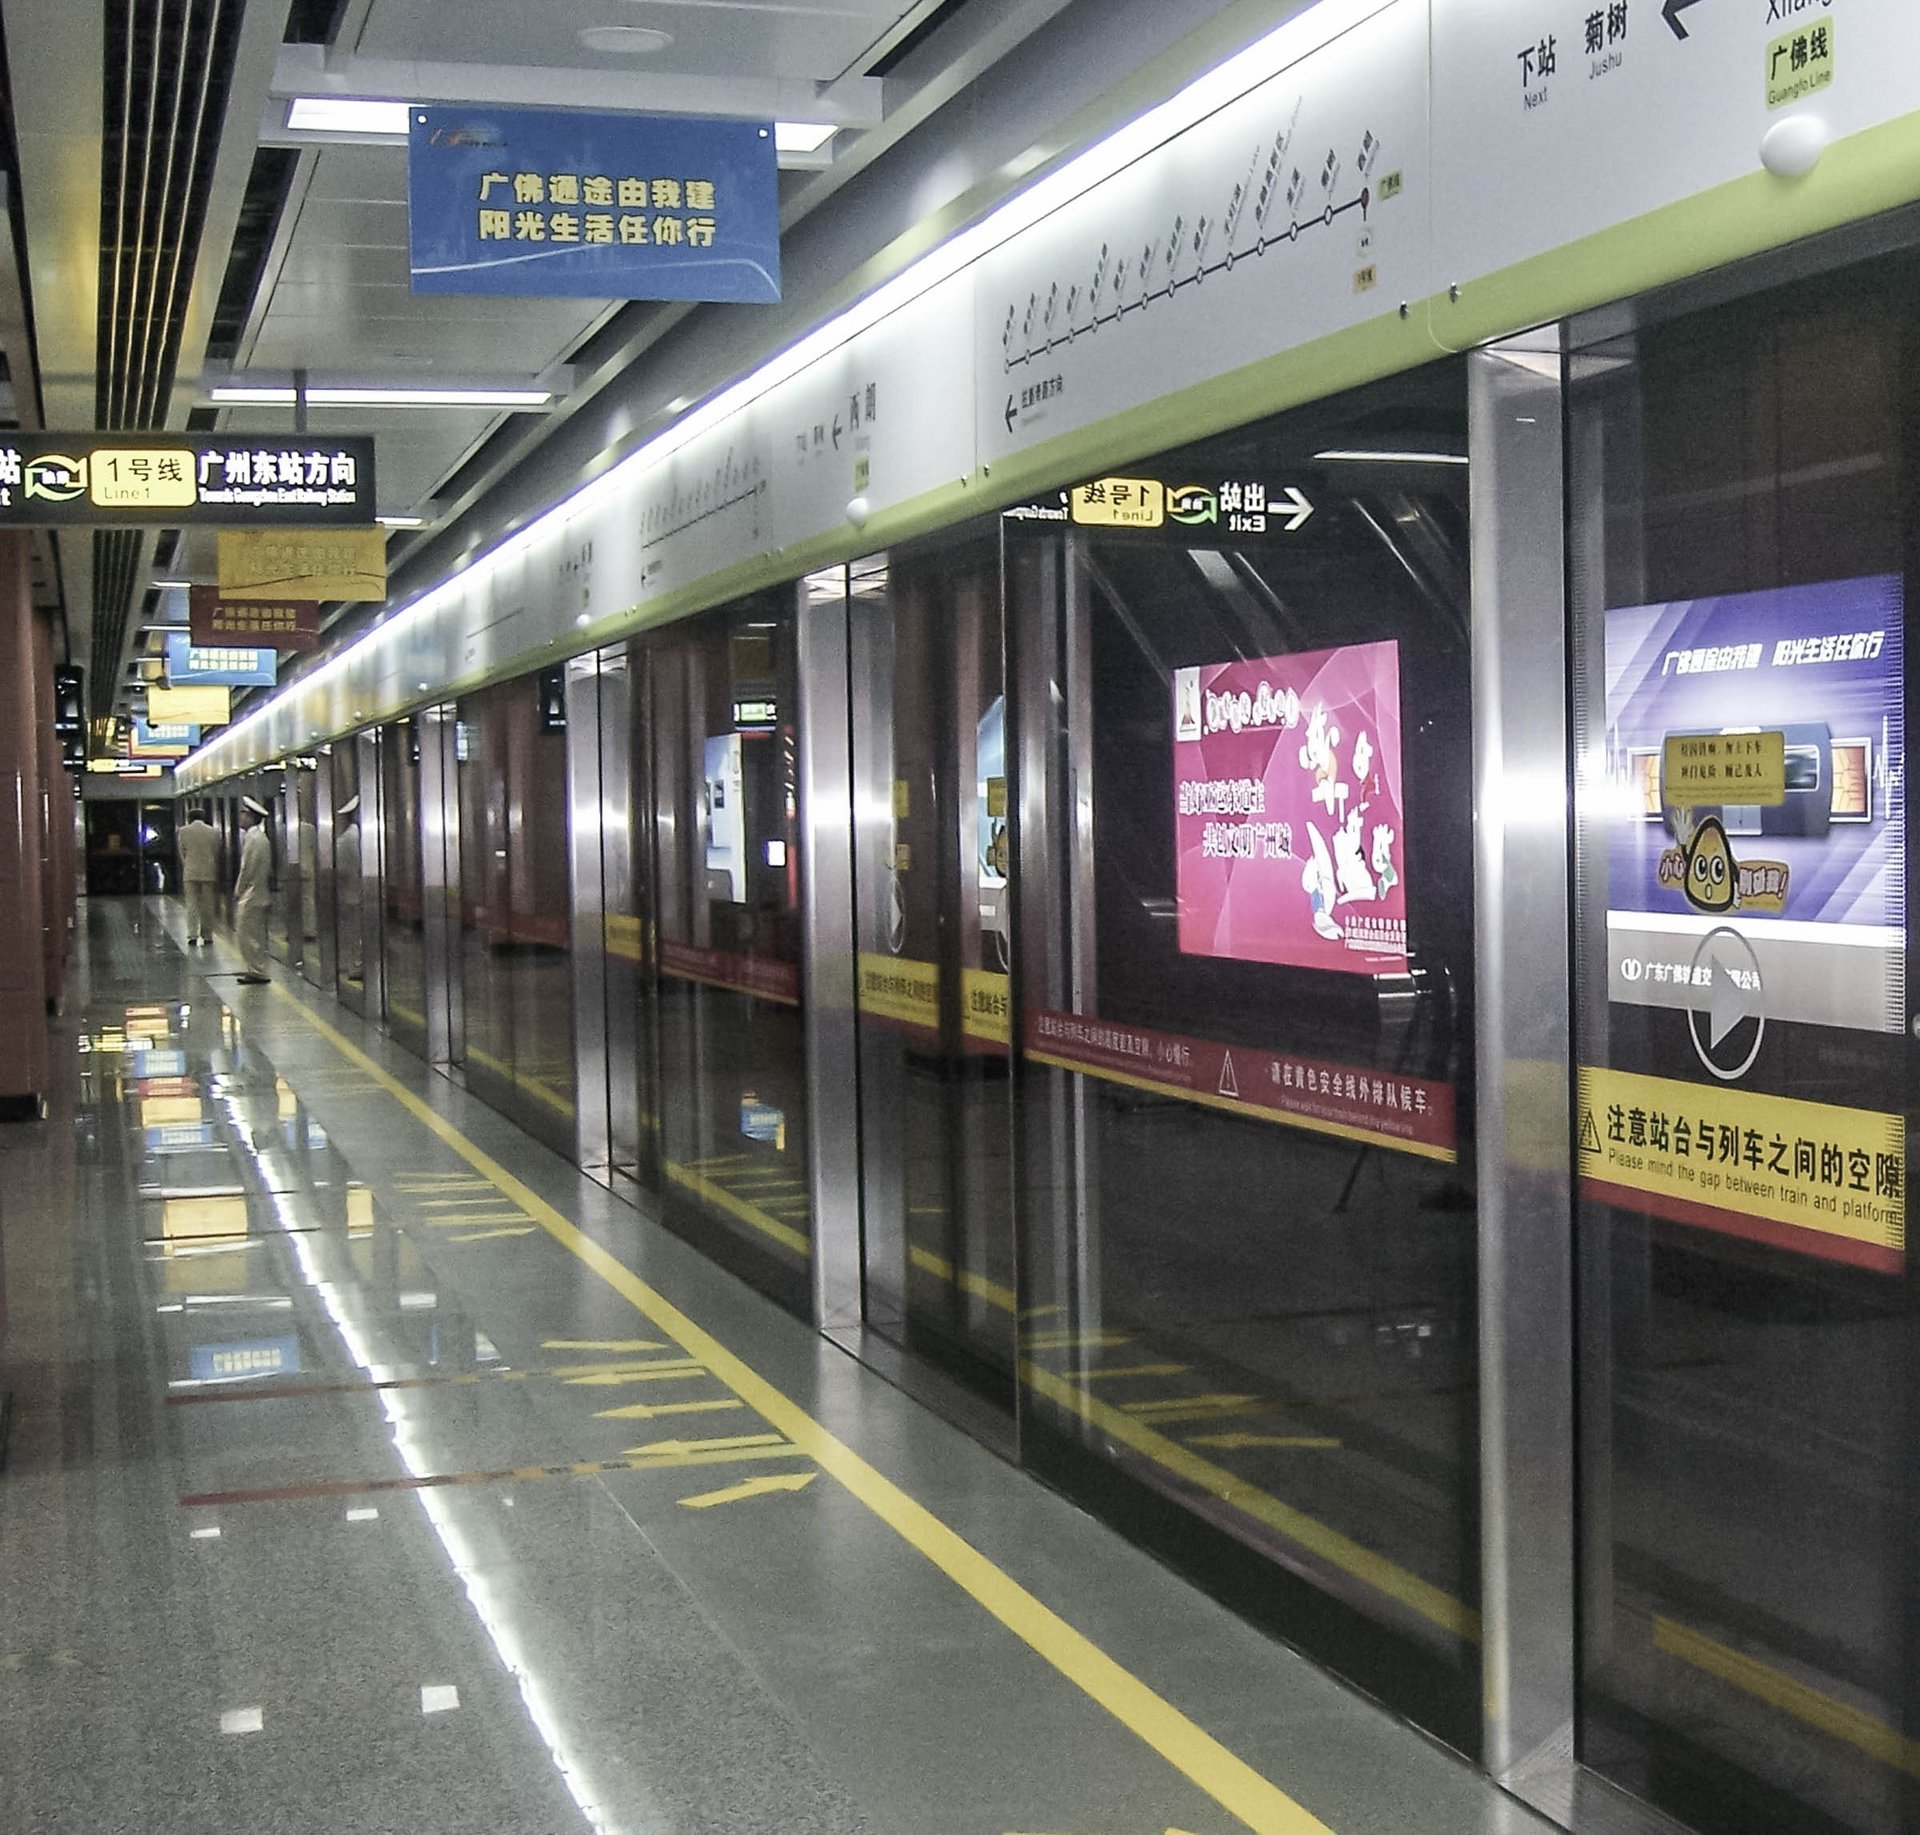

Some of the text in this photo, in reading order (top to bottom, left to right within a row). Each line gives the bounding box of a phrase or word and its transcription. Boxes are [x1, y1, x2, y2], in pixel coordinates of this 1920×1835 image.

[1584, 2, 1628, 54] 菊树
[1518, 35, 1556, 88] 下站
[1589, 52, 1623, 80] Jushu
[1771, 27, 1829, 81] 广佛线
[1809, 70, 1831, 88] Line
[1523, 87, 1548, 111] Next
[479, 172, 716, 210] 广佛通途由我建
[479, 209, 717, 247] 阳光生活任你行
[107, 458, 183, 483] 1号线
[198, 451, 356, 486] 广州东站方向
[1607, 1104, 1901, 1199] 注意站台与列车之间的空隙
[1608, 1147, 1899, 1225] Please mind the gap between train and platform
